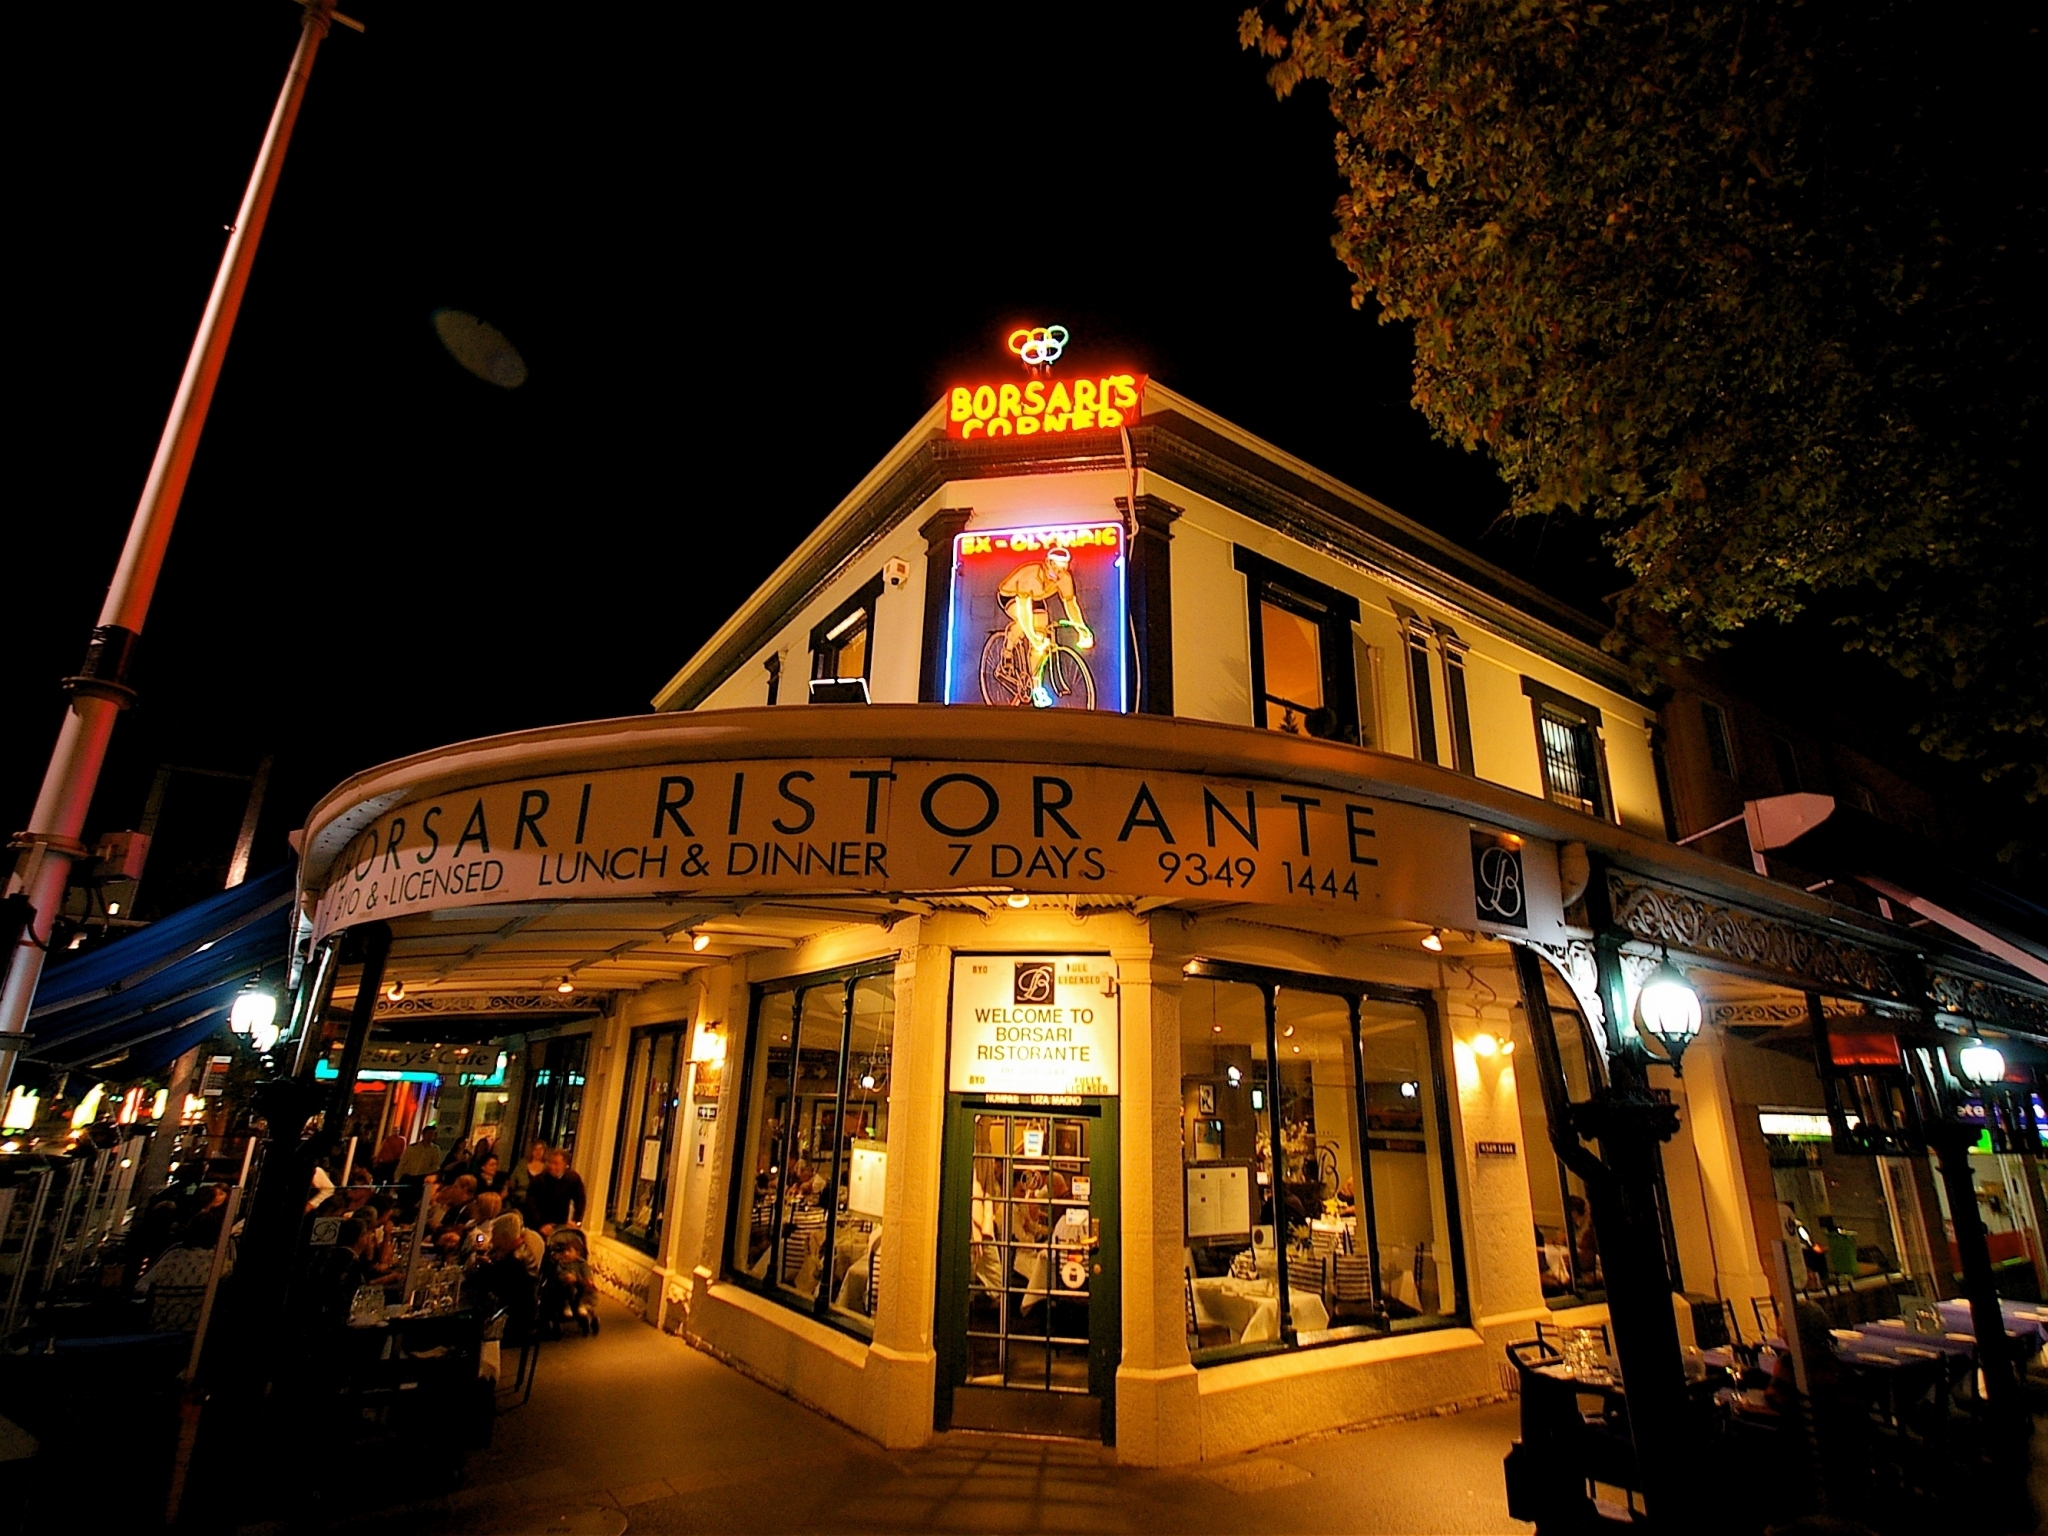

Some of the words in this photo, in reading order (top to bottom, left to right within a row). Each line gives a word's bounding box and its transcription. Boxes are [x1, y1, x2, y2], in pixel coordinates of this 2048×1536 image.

[950, 374, 1138, 422] BORSARI'S
[1010, 528, 1117, 551] OLYMPIC
[652, 769, 1379, 867] RISTORANTE
[389, 860, 504, 905] LICENSED
[538, 845, 668, 886] LUNCH
[681, 845, 710, 876] &
[725, 841, 889, 878] DINNER
[947, 843, 973, 876] 7
[990, 844, 1106, 881] DAYS
[1158, 851, 1257, 889] 9349
[1281, 861, 1360, 901] 1444
[972, 965, 988, 974] BYO
[975, 1008, 1063, 1024] WELCOME
[1070, 1008, 1094, 1024] TO
[996, 1027, 1072, 1042] BORSARI
[977, 1045, 1090, 1062] RISTORANTE
